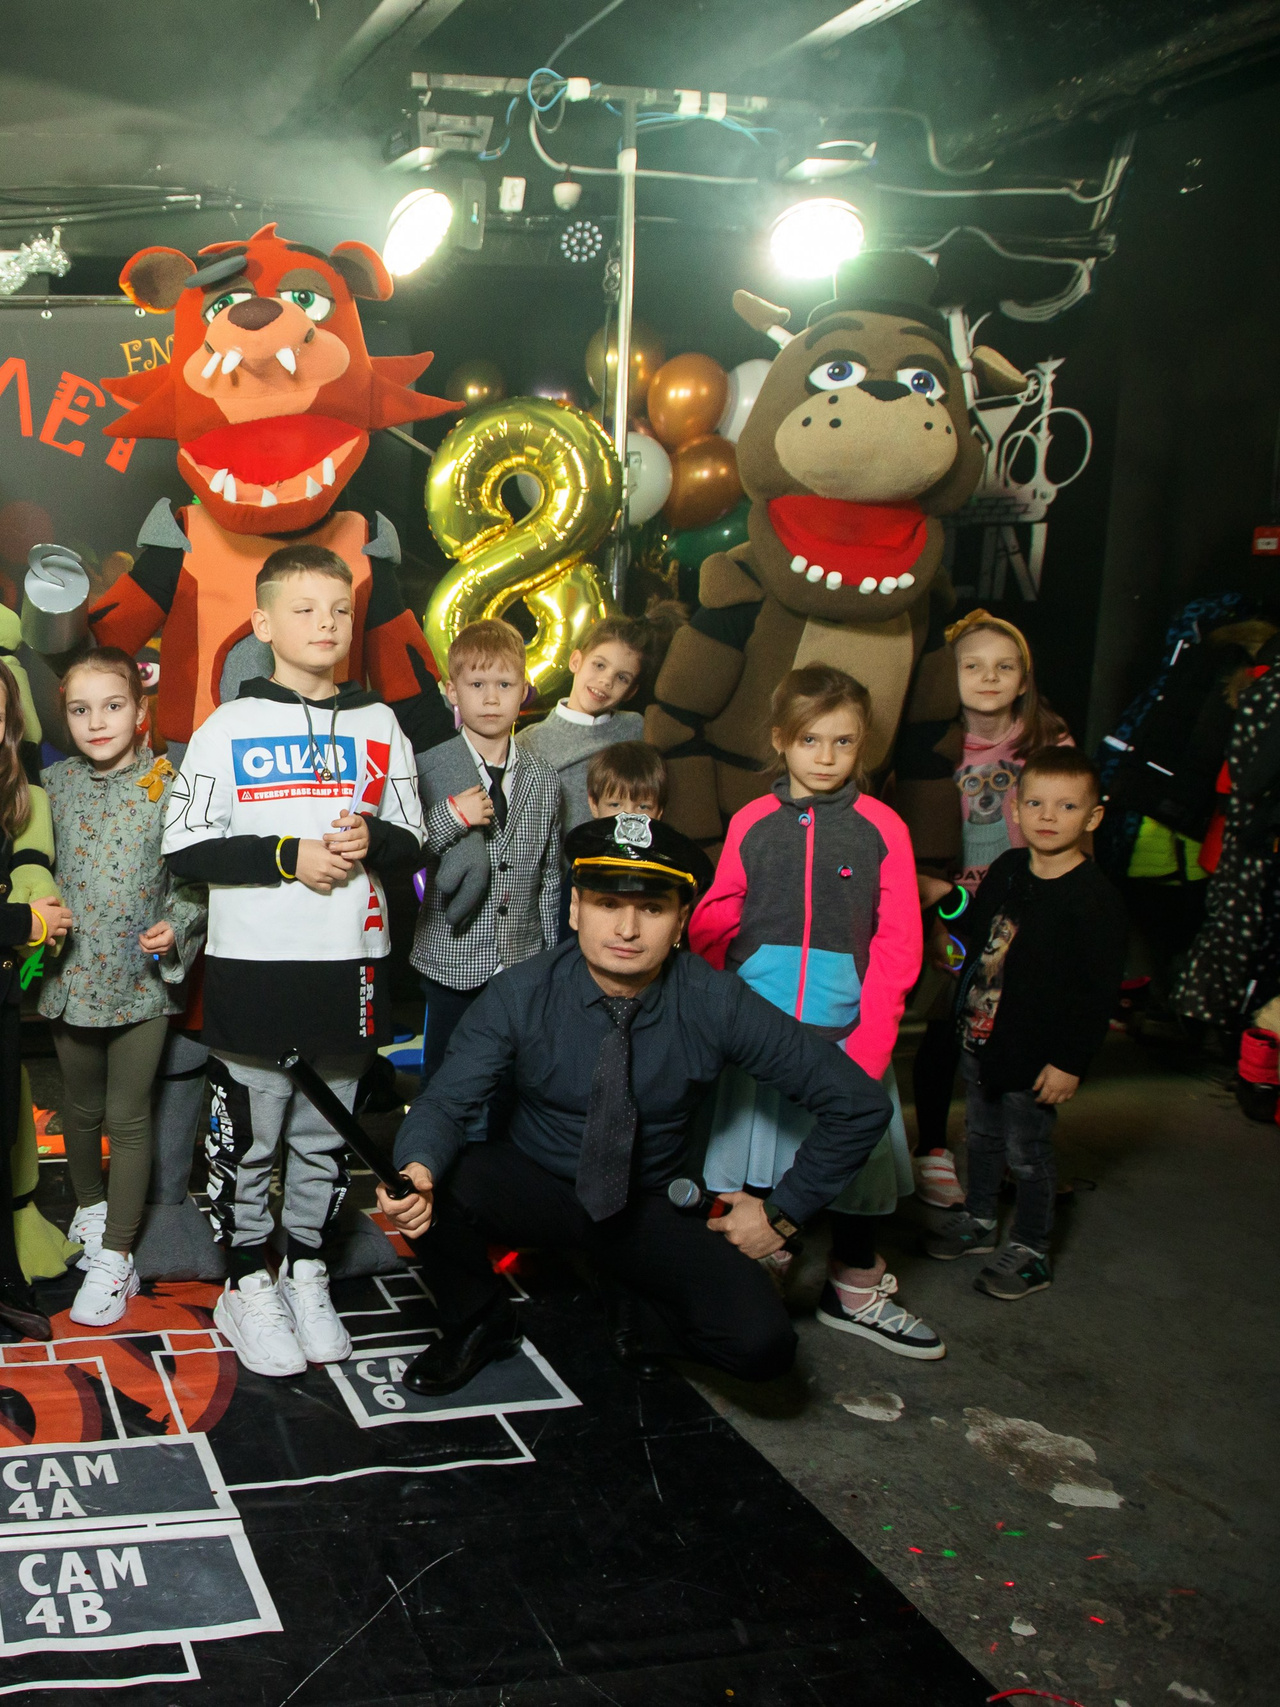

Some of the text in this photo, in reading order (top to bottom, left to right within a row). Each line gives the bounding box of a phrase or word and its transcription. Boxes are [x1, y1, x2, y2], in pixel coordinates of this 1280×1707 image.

[120, 333, 175, 375] FN
[254, 788, 289, 800] EVEREST
[291, 787, 311, 797] BASE
[312, 787, 332, 796] CAMP
[948, 869, 988, 881] DAY
[359, 965, 367, 1037] EVEREST
[356, 1355, 418, 1384] CA
[372, 1384, 406, 1410] 6
[1, 1453, 118, 1491] CAM
[8, 1488, 87, 1520] 4A
[18, 1546, 147, 1596] CAM
[25, 1593, 112, 1634] 4B
